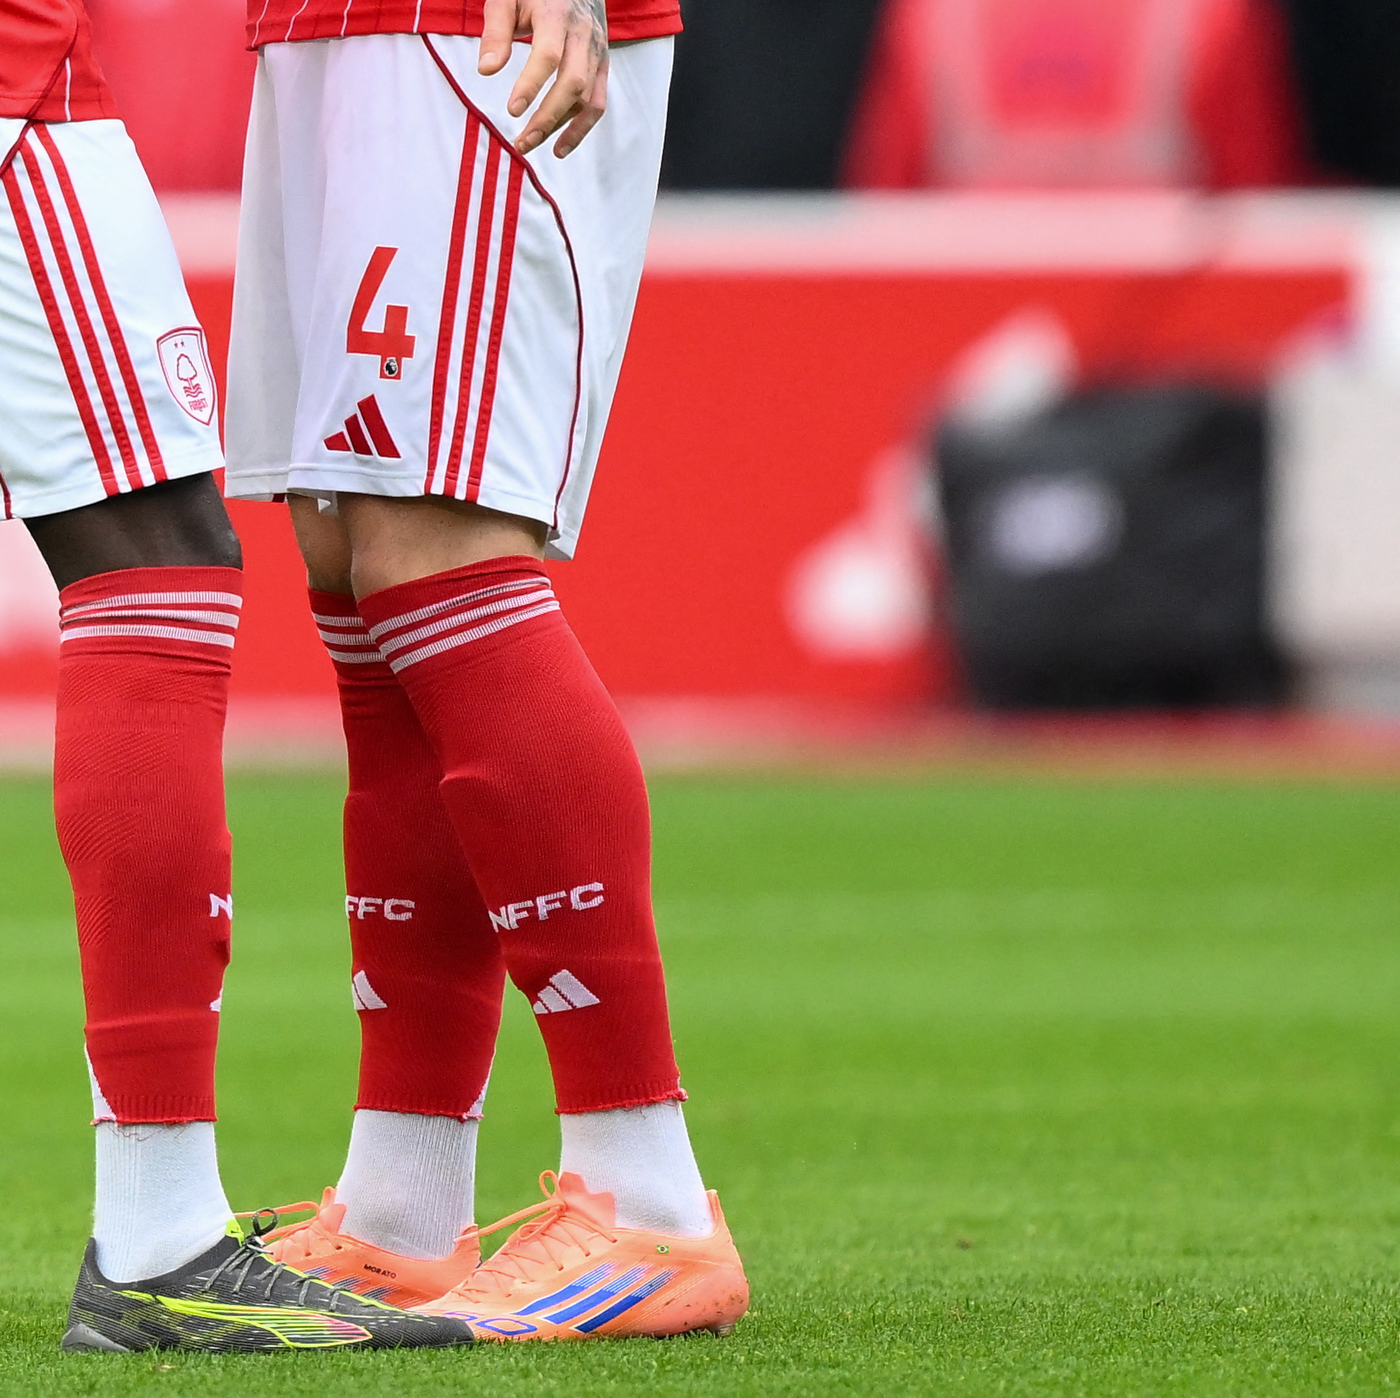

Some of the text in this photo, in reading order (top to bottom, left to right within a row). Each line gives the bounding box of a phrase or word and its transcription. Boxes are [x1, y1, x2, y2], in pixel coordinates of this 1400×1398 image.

[346, 246, 417, 381] 4
[344, 894, 416, 921] FFC
[488, 881, 604, 933] NFFC
[363, 1263, 398, 1279] MORATO
